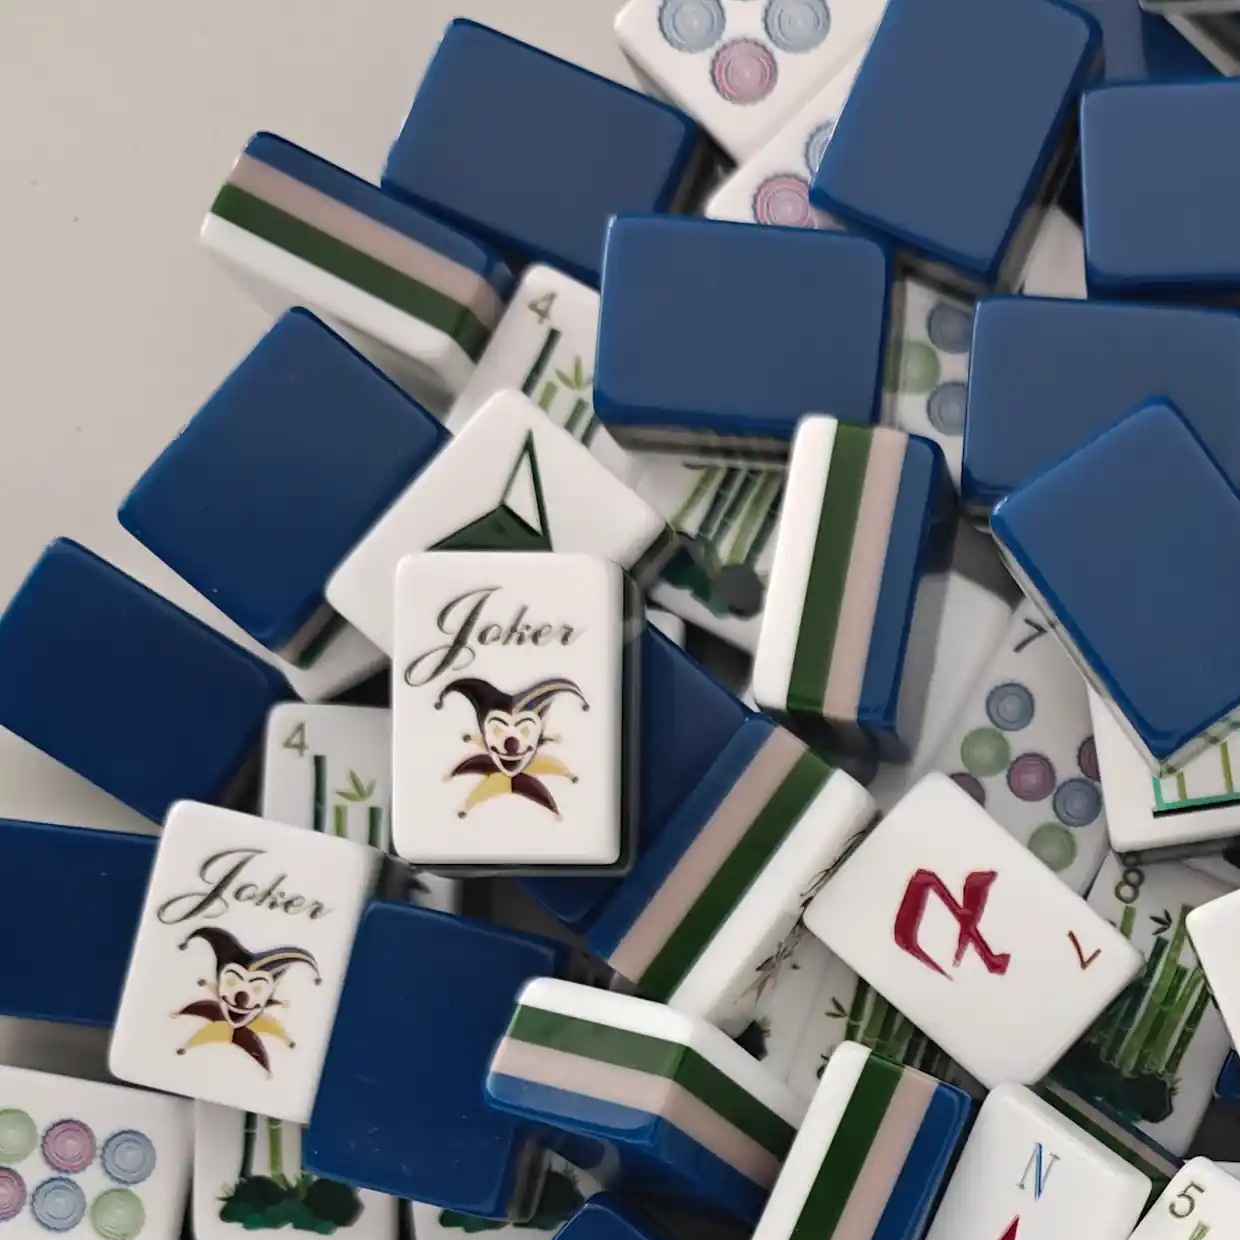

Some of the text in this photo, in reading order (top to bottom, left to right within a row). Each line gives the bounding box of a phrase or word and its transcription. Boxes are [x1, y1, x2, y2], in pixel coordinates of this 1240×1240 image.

[528, 291, 557, 324] 4
[403, 587, 587, 687] Joker
[1013, 618, 1049, 654] 7
[283, 720, 309, 757] 4
[156, 848, 337, 925] Joker
[1068, 930, 1102, 971] 7
[1016, 1142, 1061, 1202] N
[1169, 1181, 1205, 1219] 5
